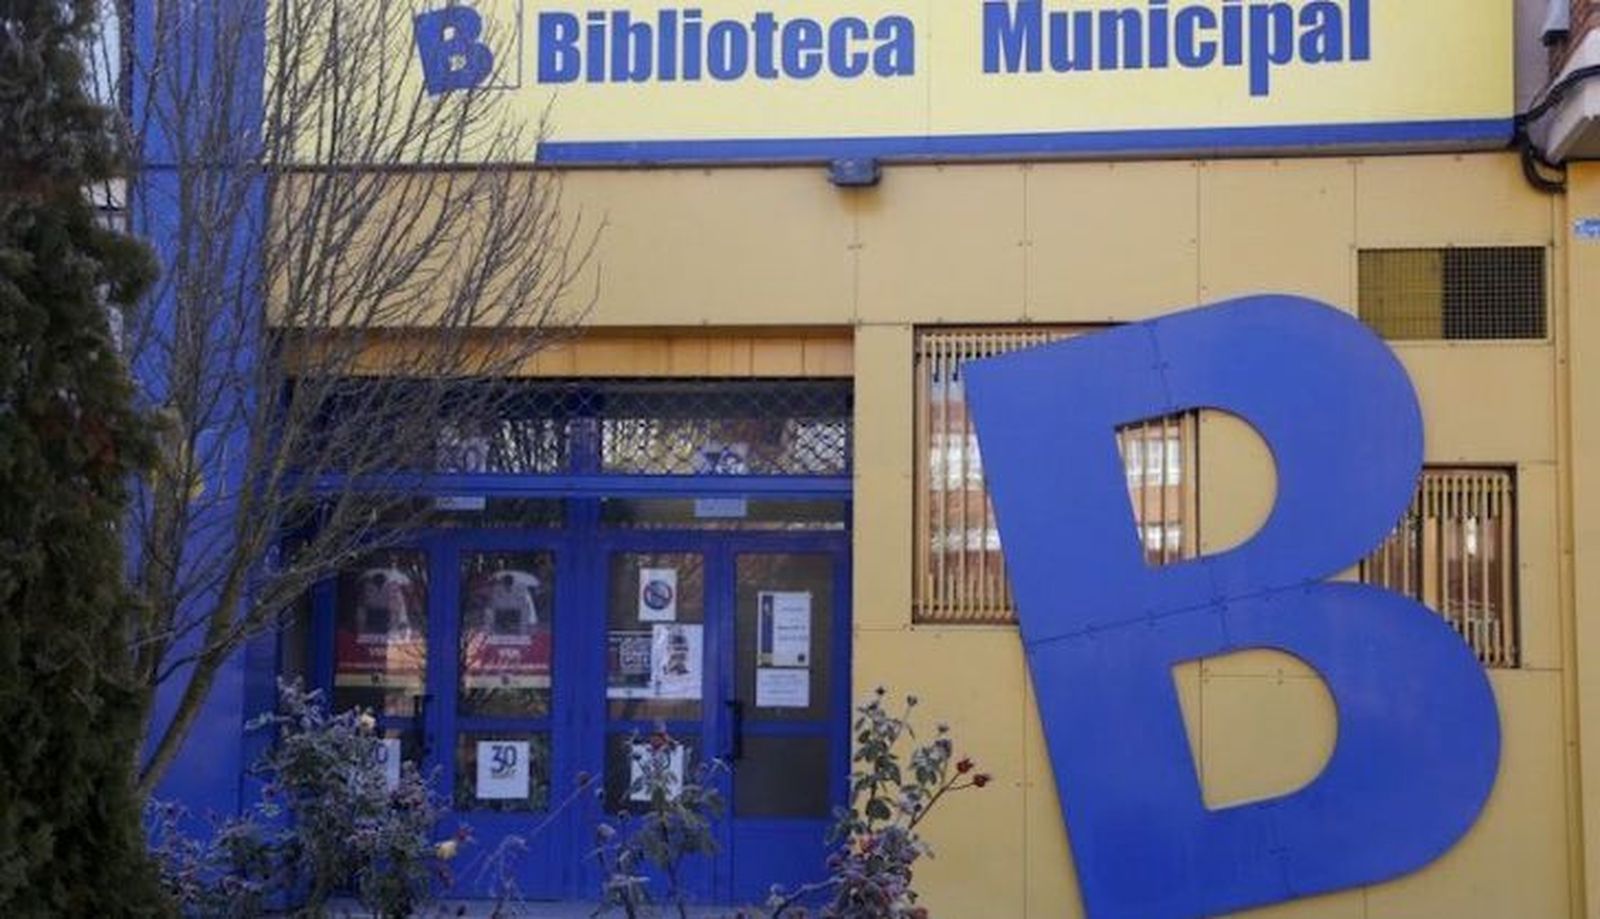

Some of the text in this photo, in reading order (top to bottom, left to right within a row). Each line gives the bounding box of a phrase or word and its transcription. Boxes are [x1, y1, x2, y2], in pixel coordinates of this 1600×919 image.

[415, 5, 494, 97] B
[537, 0, 1371, 97] Biblioteca Municipal
[962, 294, 1502, 919] B
[491, 745, 518, 774] 30
